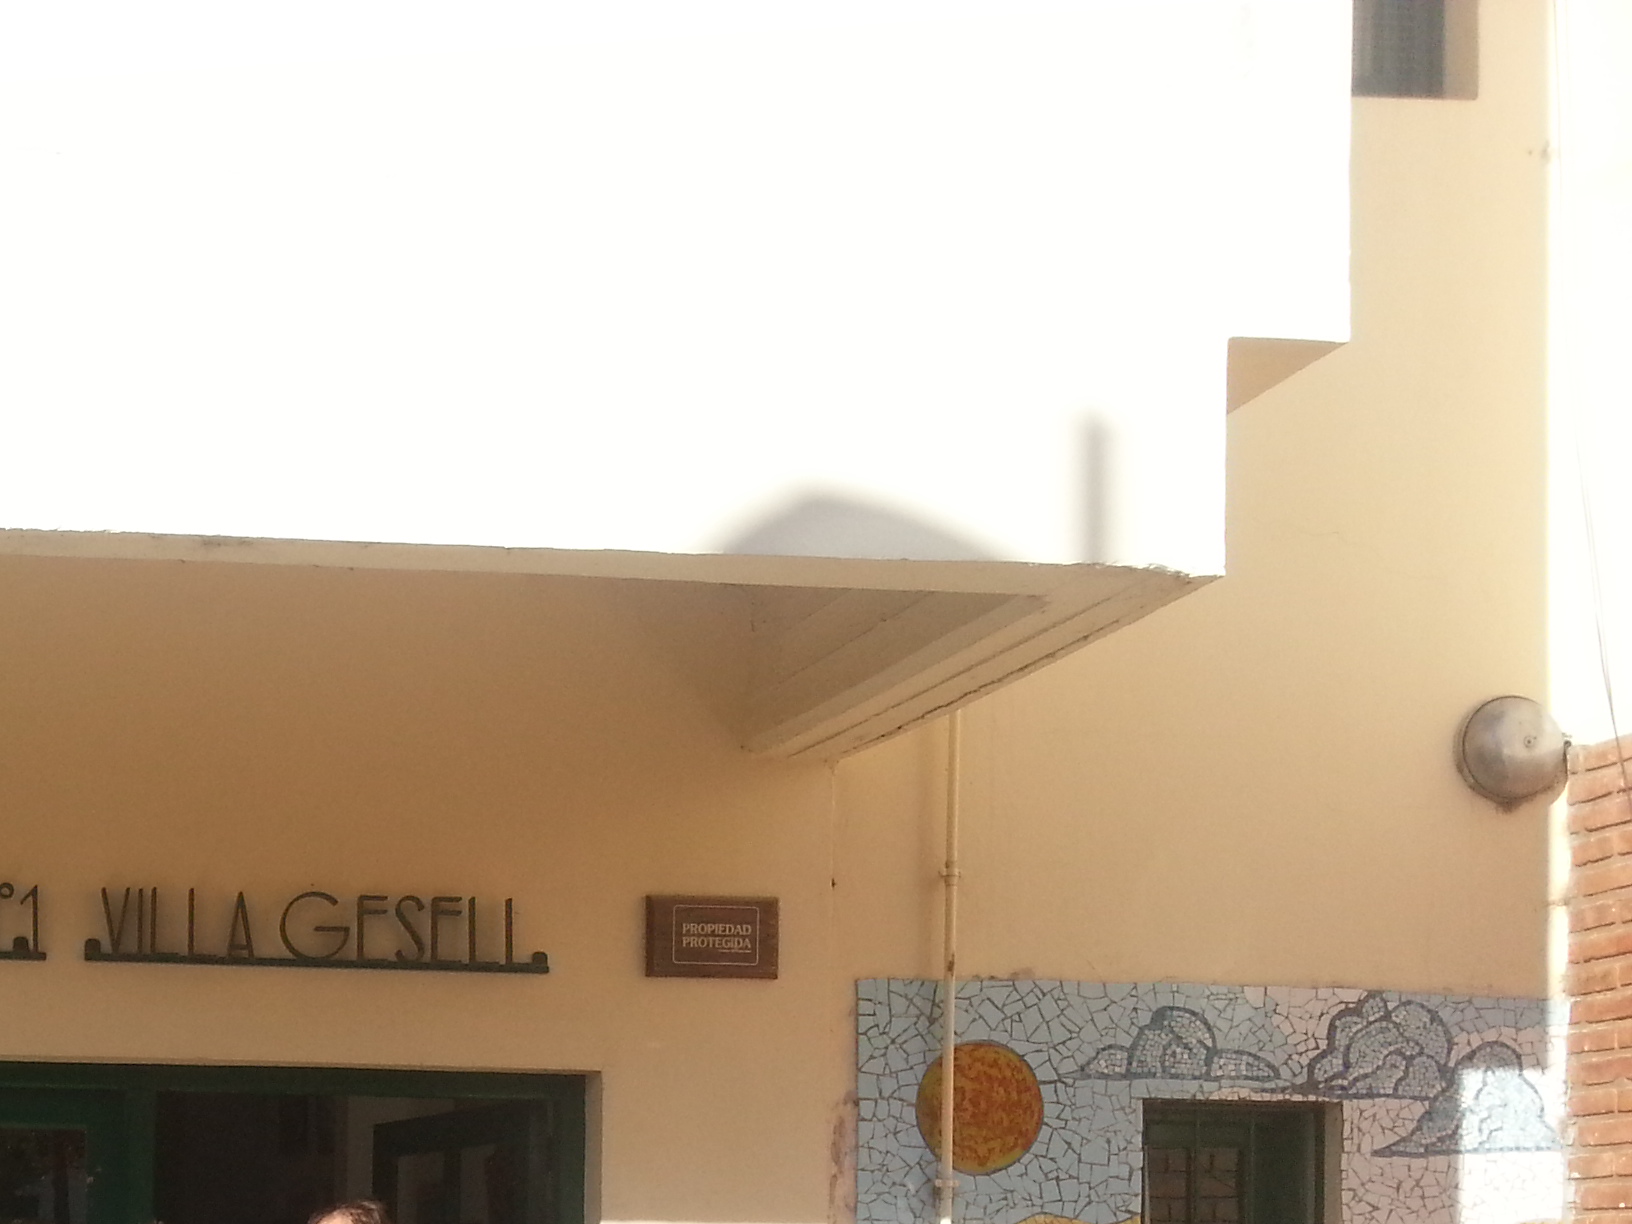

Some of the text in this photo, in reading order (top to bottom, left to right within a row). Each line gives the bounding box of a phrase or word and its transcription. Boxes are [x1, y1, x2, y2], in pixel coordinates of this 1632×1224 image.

[99, 885, 256, 959] VILLA
[279, 891, 514, 966] GESELL
[682, 923, 752, 935] PROPIEDAD
[682, 936, 752, 948] PROTEGIDA
